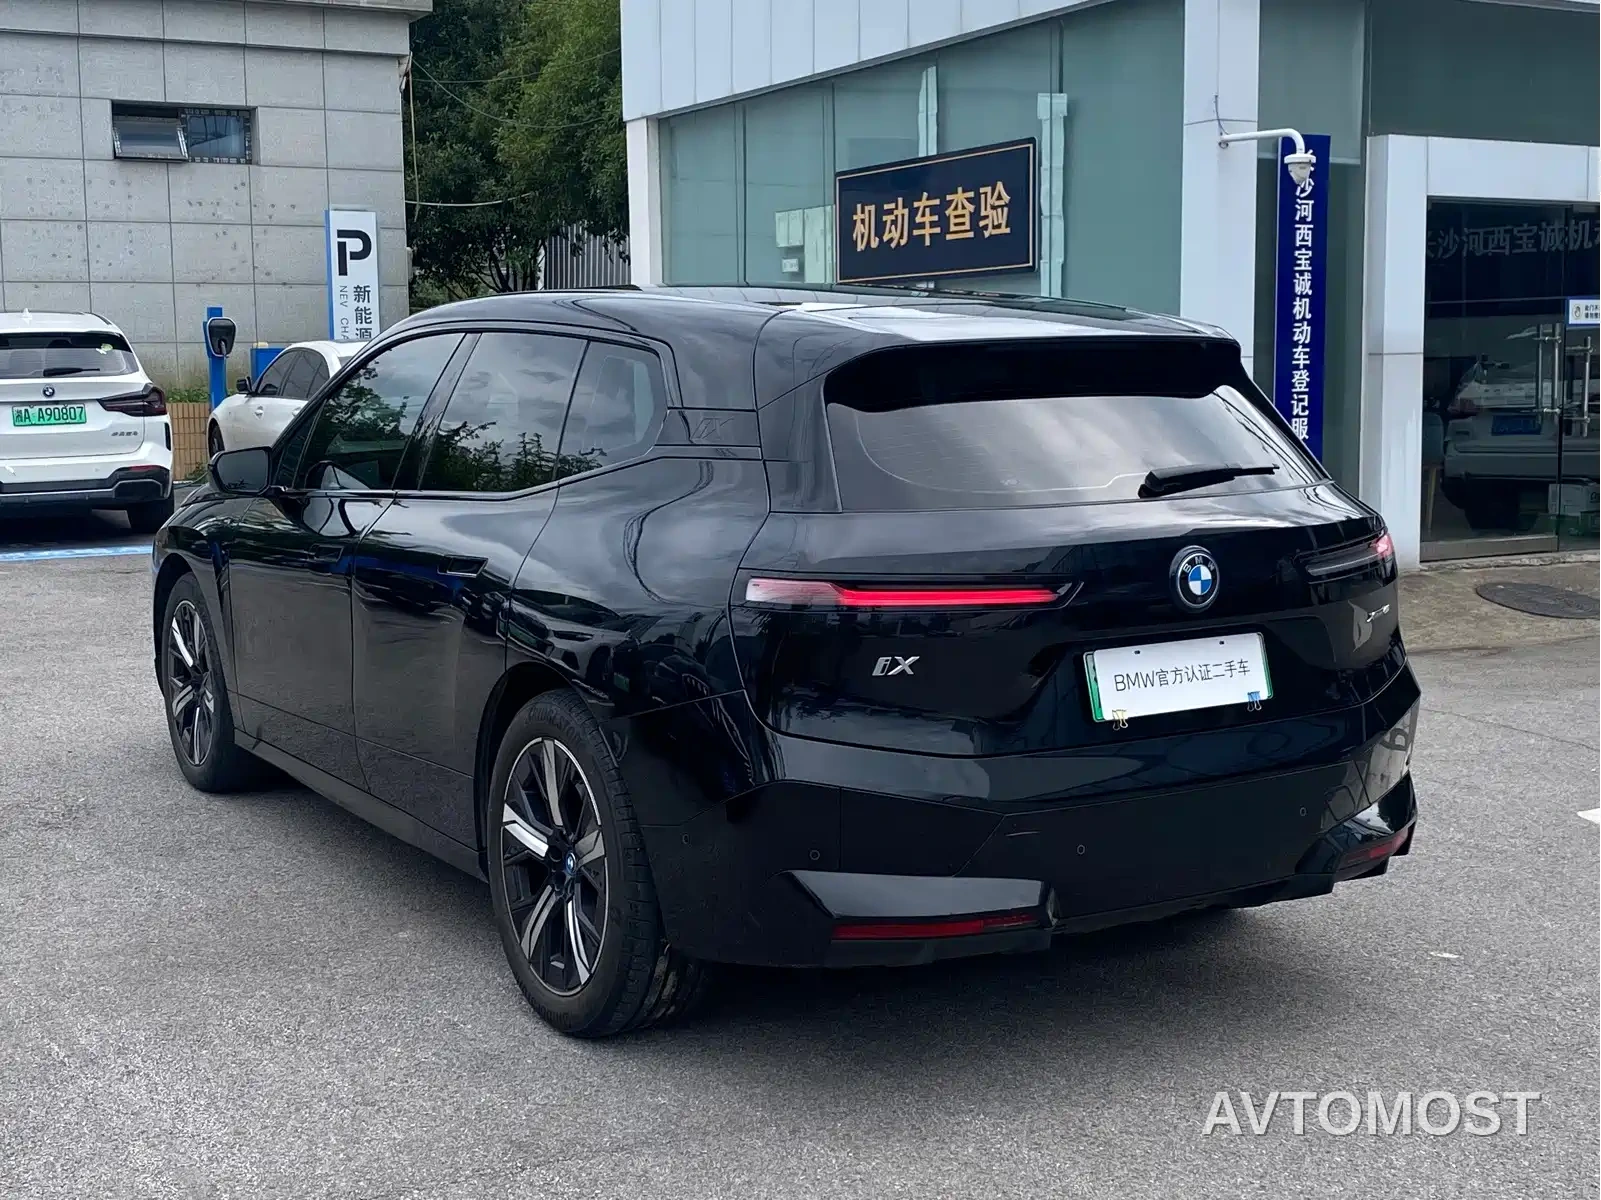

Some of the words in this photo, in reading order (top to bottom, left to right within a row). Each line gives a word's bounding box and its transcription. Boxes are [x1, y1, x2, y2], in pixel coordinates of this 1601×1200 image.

[852, 181, 1011, 252] 机动车查验
[337, 229, 372, 276] P
[339, 285, 349, 308] NEV
[1290, 149, 1315, 440] 沙河西宝诚机动车登记服
[38, 406, 84, 422] A90807
[1182, 555, 1215, 574] BMW
[871, 655, 920, 677] iX
